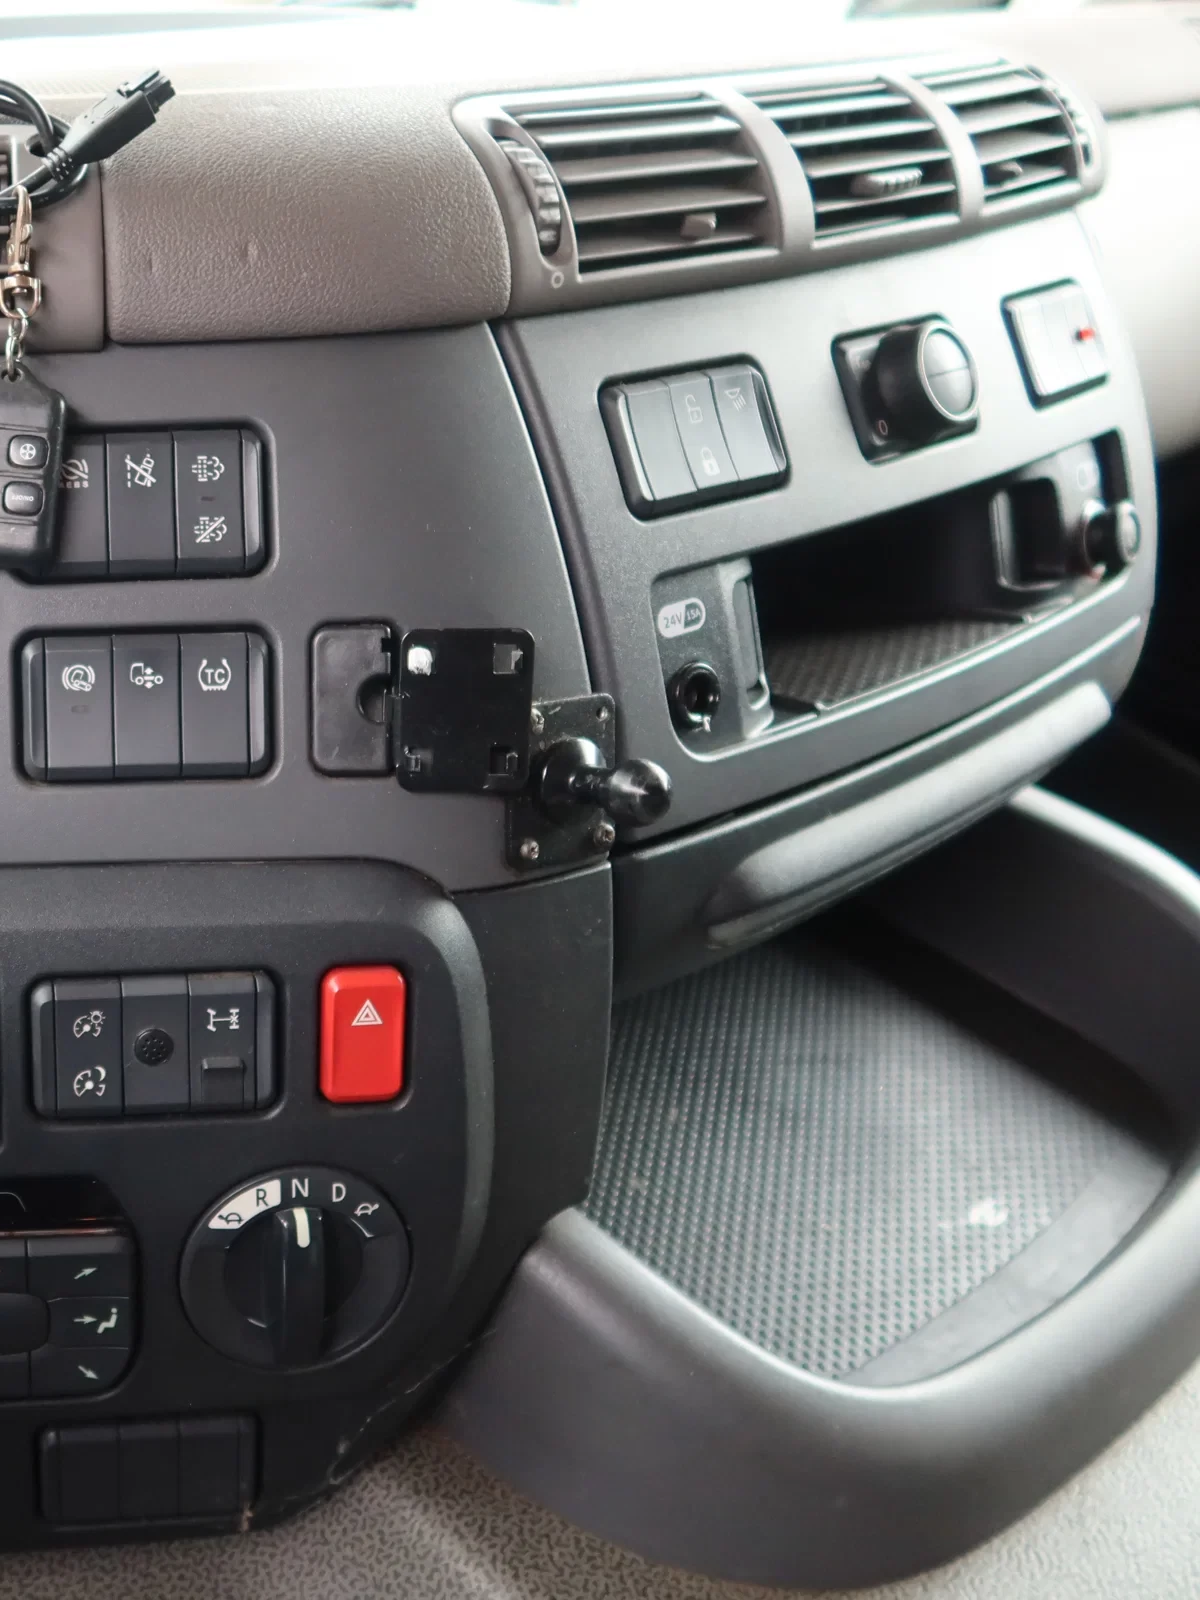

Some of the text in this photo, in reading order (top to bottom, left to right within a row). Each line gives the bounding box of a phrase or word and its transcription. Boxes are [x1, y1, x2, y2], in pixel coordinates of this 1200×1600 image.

[663, 607, 702, 630] 24V 15A
[204, 668, 226, 684] TC
[256, 1178, 347, 1207] R N D
